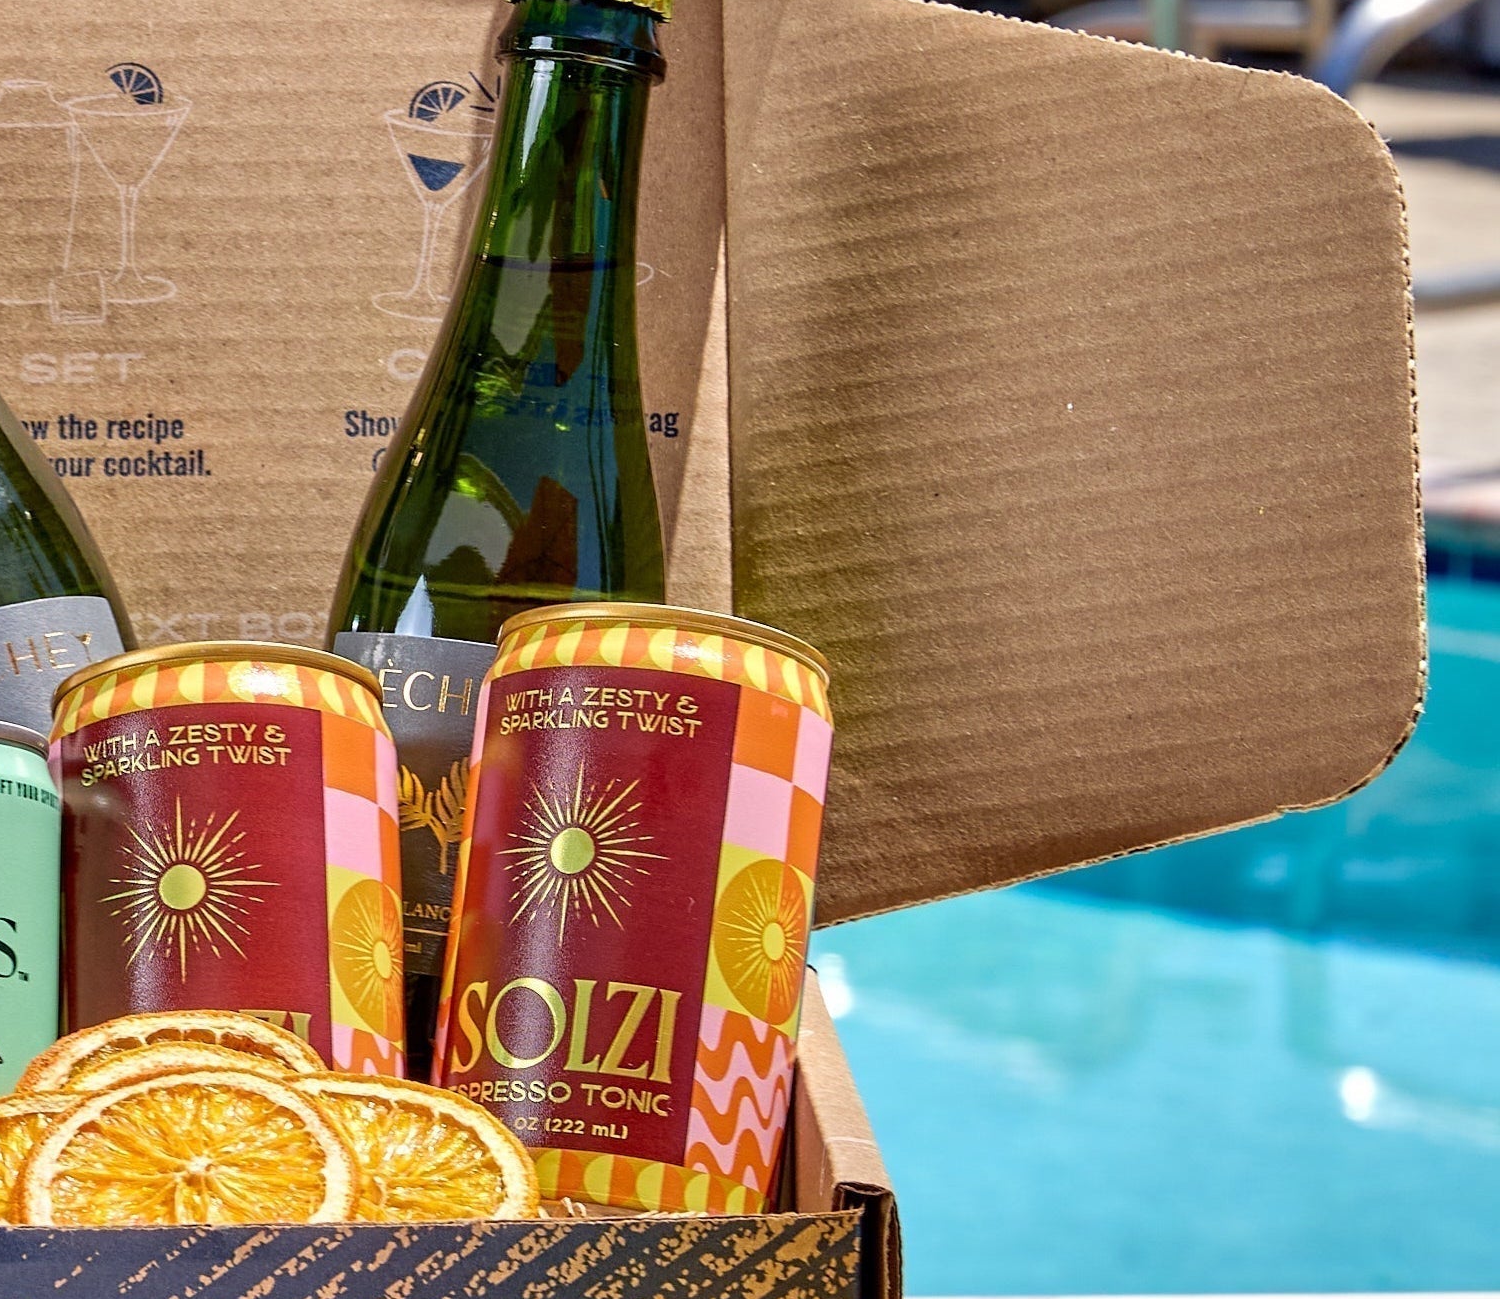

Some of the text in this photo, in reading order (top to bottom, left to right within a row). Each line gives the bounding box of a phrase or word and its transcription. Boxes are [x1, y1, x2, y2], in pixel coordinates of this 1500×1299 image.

[19, 350, 147, 385] SET
[57, 413, 98, 441] the
[106, 413, 185, 445] recipe
[645, 411, 681, 439] ag
[103, 449, 212, 478] cocktail.
[239, 610, 329, 641] BO
[505, 686, 700, 716] WITH A ZESTY &
[499, 708, 703, 739] SPARKLING TWIST
[82, 722, 287, 764] WITH A ZESTY &
[79, 744, 293, 788] SPARKLING TWIST
[449, 976, 684, 1085] SOLZI
[580, 1082, 672, 1118] TONIC
[514, 1116, 630, 1141] OZ (222 mL)
